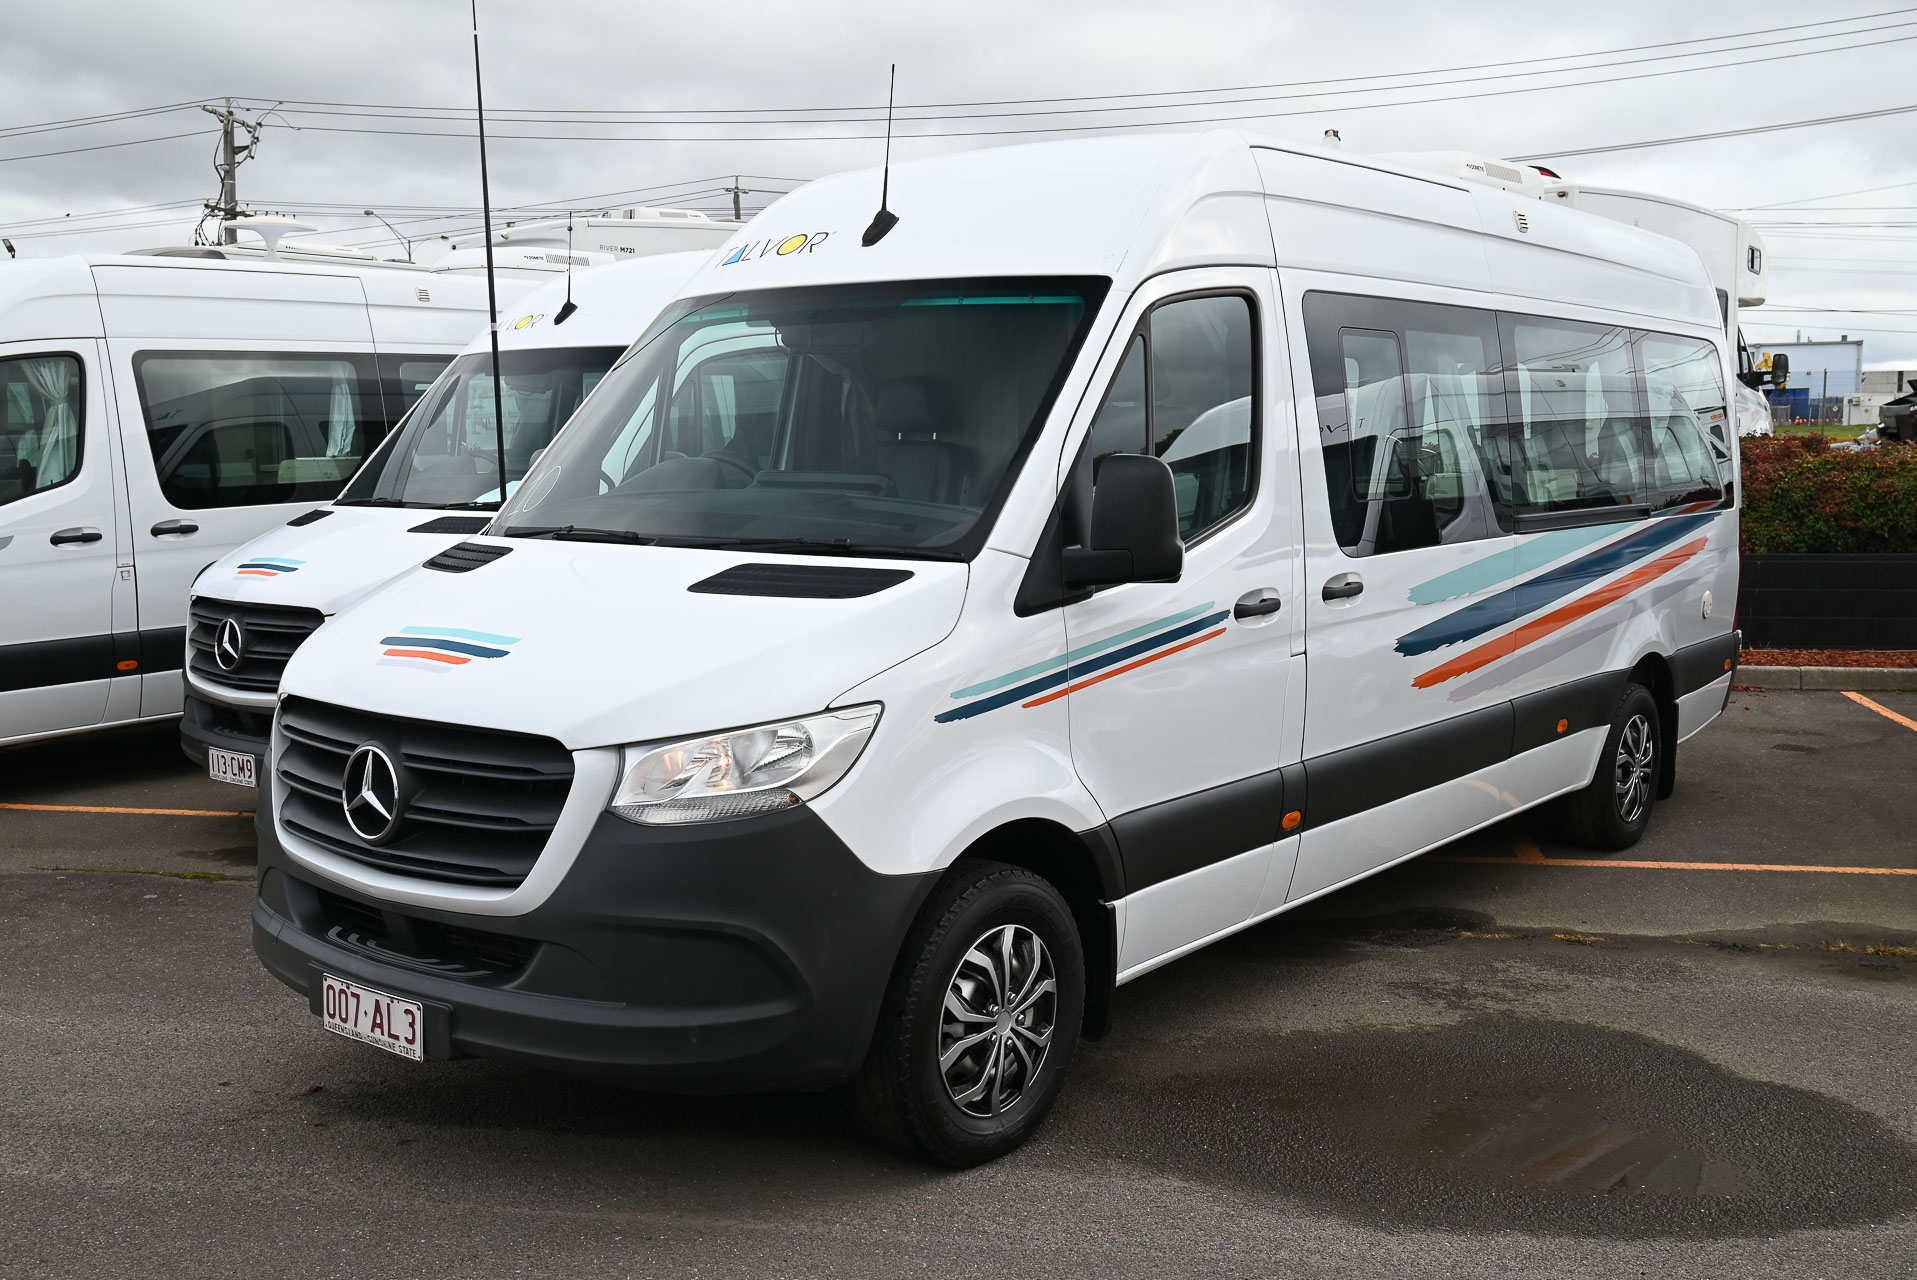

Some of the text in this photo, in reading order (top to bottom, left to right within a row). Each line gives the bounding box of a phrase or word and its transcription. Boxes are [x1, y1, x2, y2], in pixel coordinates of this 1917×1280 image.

[599, 244, 636, 254] RIVER M721
[327, 1020, 362, 1040] QUEENSLAND
[367, 1034, 397, 1052] SUNSHINE
[398, 1044, 417, 1058] STATE
